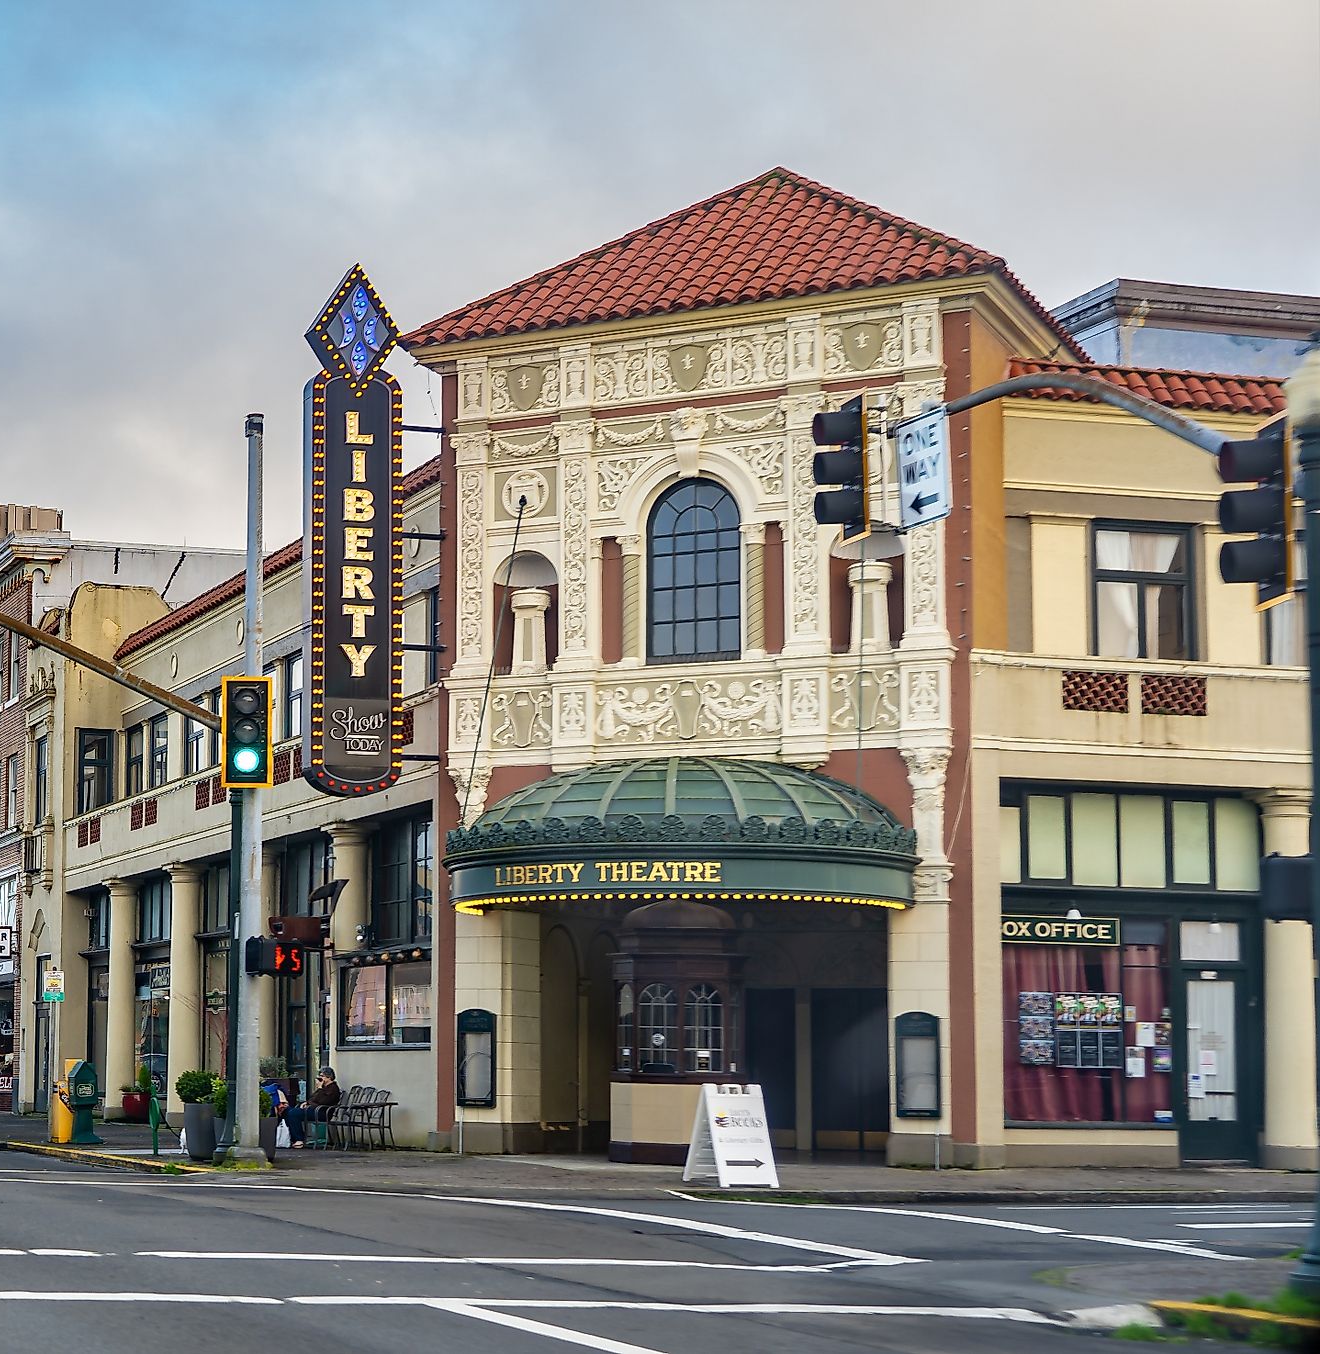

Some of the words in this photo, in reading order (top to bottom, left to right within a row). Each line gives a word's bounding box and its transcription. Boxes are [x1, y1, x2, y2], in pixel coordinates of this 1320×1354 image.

[903, 423, 939, 456] ONE
[902, 452, 941, 486] WAY
[340, 411, 377, 677] LIBERTY
[329, 706, 388, 740] Show
[344, 738, 385, 752] TODAY
[495, 862, 585, 887] LIBERTY
[594, 860, 722, 883] THEATRE
[1001, 921, 1032, 937] OX
[1034, 922, 1112, 939] OFFICE
